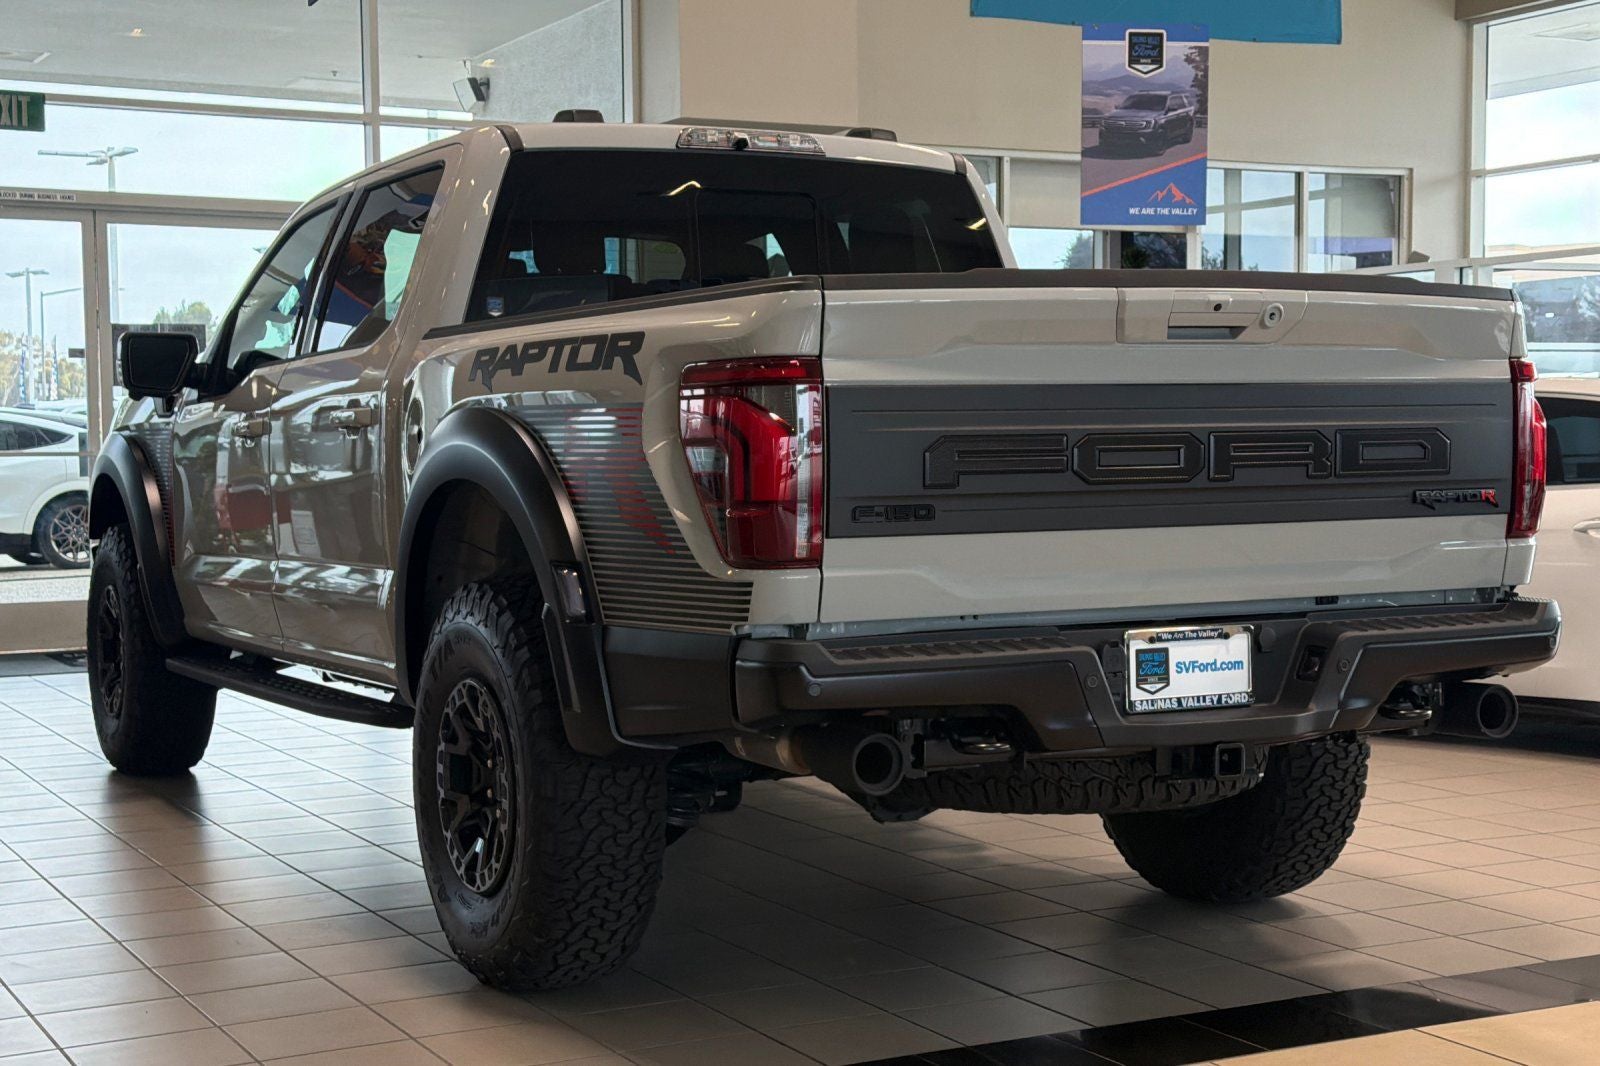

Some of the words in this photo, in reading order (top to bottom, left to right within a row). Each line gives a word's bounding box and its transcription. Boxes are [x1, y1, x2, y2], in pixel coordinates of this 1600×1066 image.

[1131, 44, 1159, 57] Ford
[1129, 207, 1140, 215] WE
[1141, 207, 1155, 215] ARE
[1157, 207, 1170, 215] THE
[1171, 207, 1198, 215] VALLEY
[468, 331, 646, 393] RAPTOR
[922, 427, 1451, 490] FORD
[1412, 487, 1499, 511] RAPTOR
[851, 503, 936, 523] F-150
[1185, 631, 1197, 639] The
[1139, 660, 1166, 675] Ford
[1175, 658, 1244, 674] SVFord.com
[1135, 697, 1179, 711] SALINAS
[1181, 694, 1219, 707] VALLEY
[1221, 692, 1249, 705] FORD
